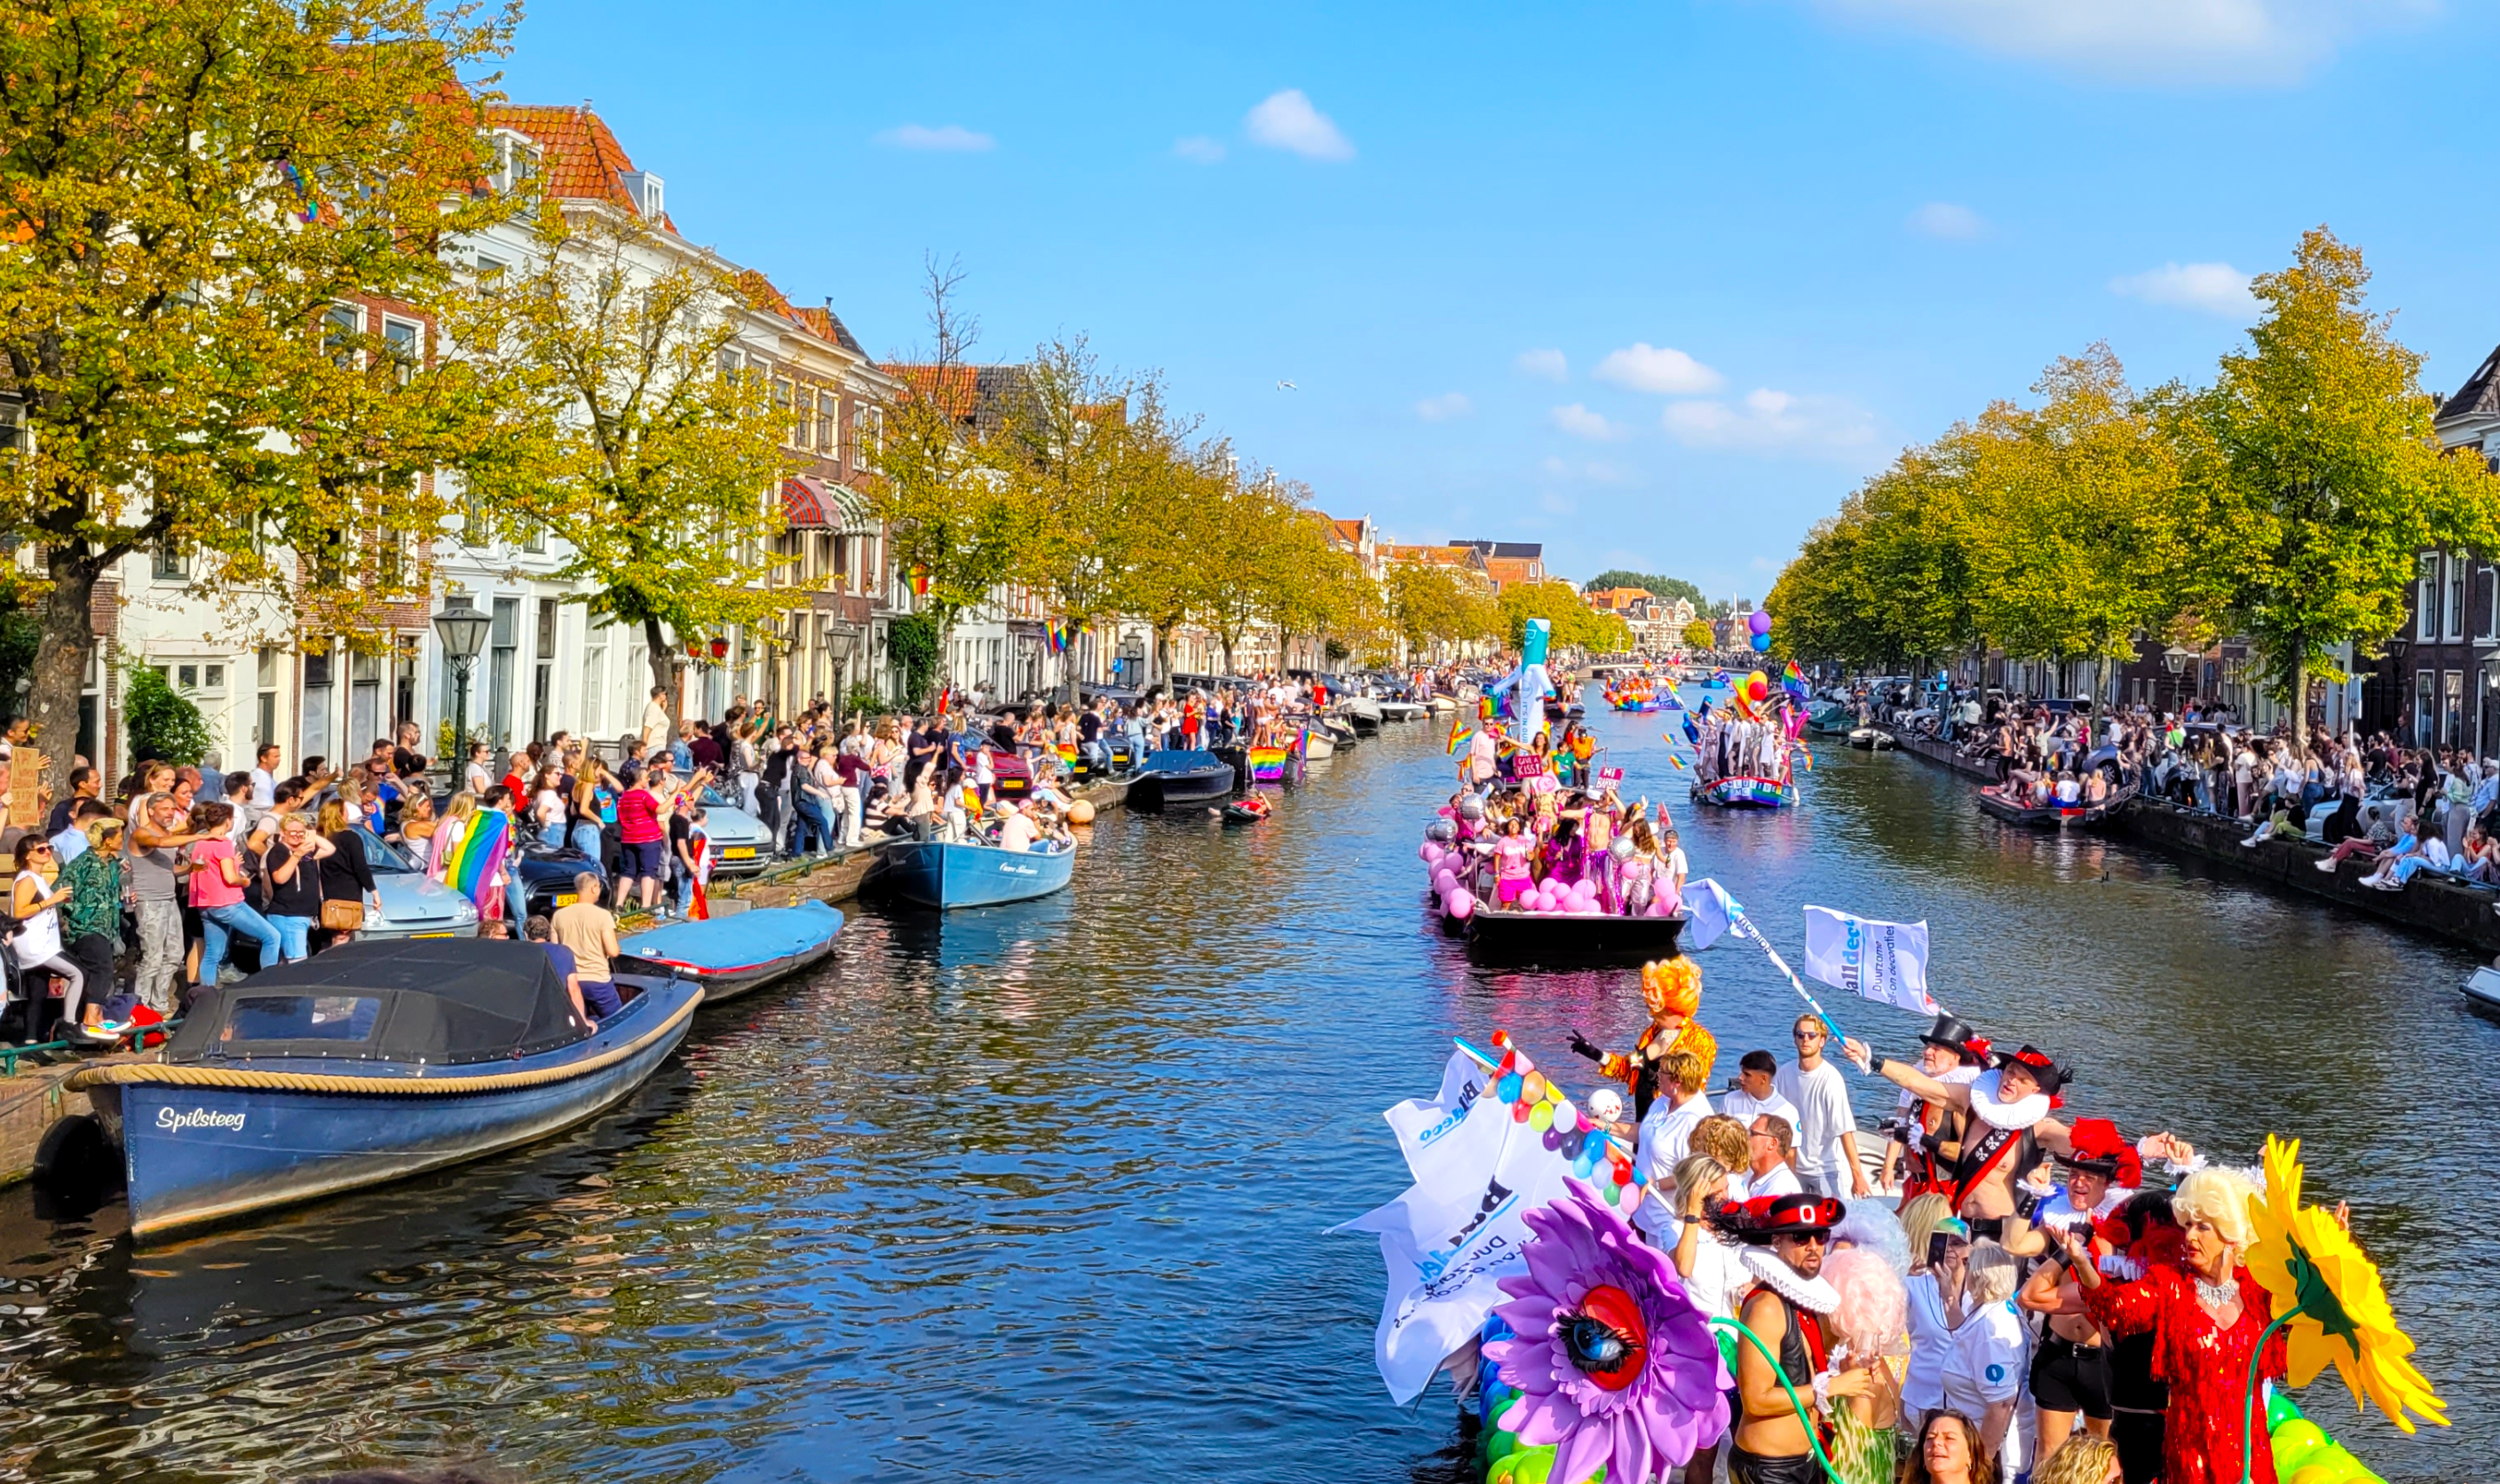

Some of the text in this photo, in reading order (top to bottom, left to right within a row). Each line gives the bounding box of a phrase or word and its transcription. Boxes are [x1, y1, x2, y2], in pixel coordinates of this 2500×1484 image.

[1517, 763, 1540, 776] KISS!
[1872, 940, 1884, 992] Duurzame
[155, 1107, 246, 1133] Spilsteeg
